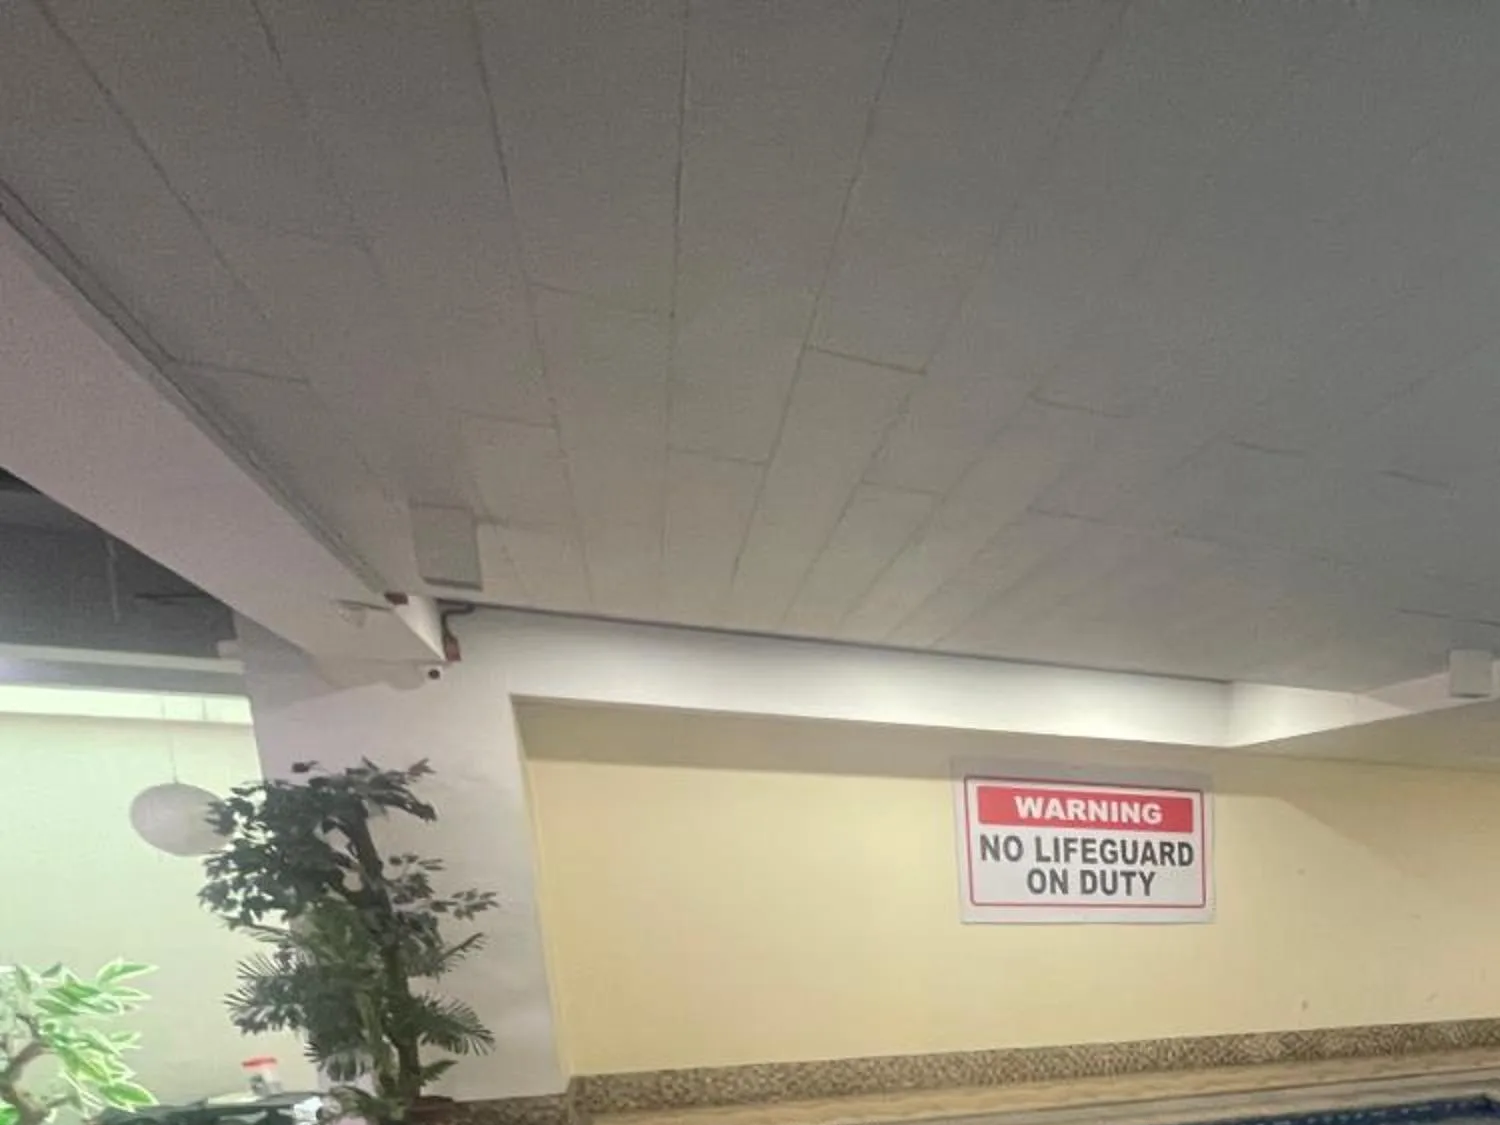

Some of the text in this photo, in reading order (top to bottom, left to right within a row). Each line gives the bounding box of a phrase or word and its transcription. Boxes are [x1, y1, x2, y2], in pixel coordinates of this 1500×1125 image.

[1013, 795, 1163, 825] WARNING
[980, 833, 1194, 867] NO LIFEGUARD
[1027, 867, 1156, 897] ON DUTY
